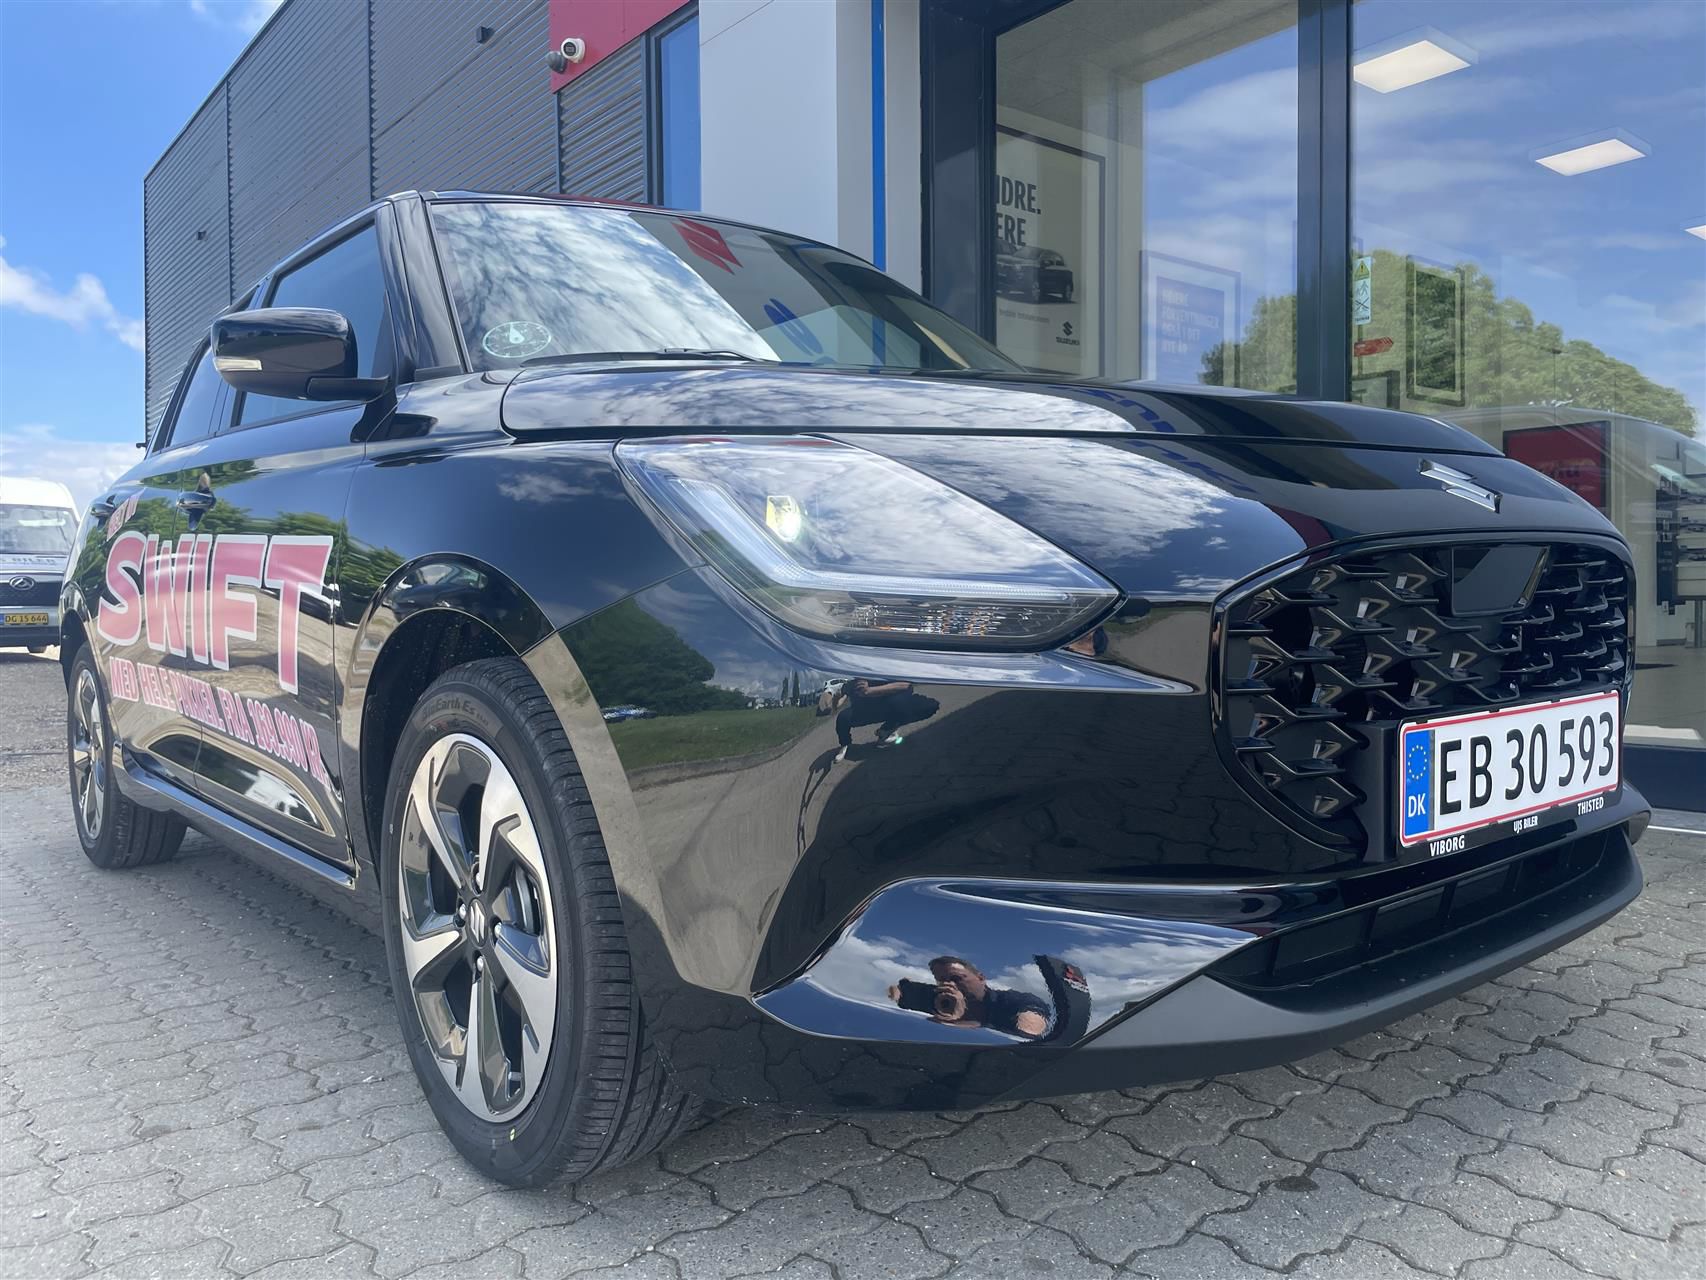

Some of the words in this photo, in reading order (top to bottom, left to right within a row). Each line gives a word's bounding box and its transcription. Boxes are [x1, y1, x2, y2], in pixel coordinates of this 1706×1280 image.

[97, 531, 334, 696] SWIFT
[109, 656, 139, 701] MED
[137, 662, 177, 712] HELE
[216, 686, 255, 746] FRA
[1439, 735, 1492, 816] EB
[1504, 723, 1548, 801] 30
[1558, 711, 1614, 788] 593
[1408, 793, 1426, 818] DK
[1577, 797, 1604, 816] THISTED
[1523, 815, 1538, 828] BILER
[1429, 834, 1465, 857] VIBORG
